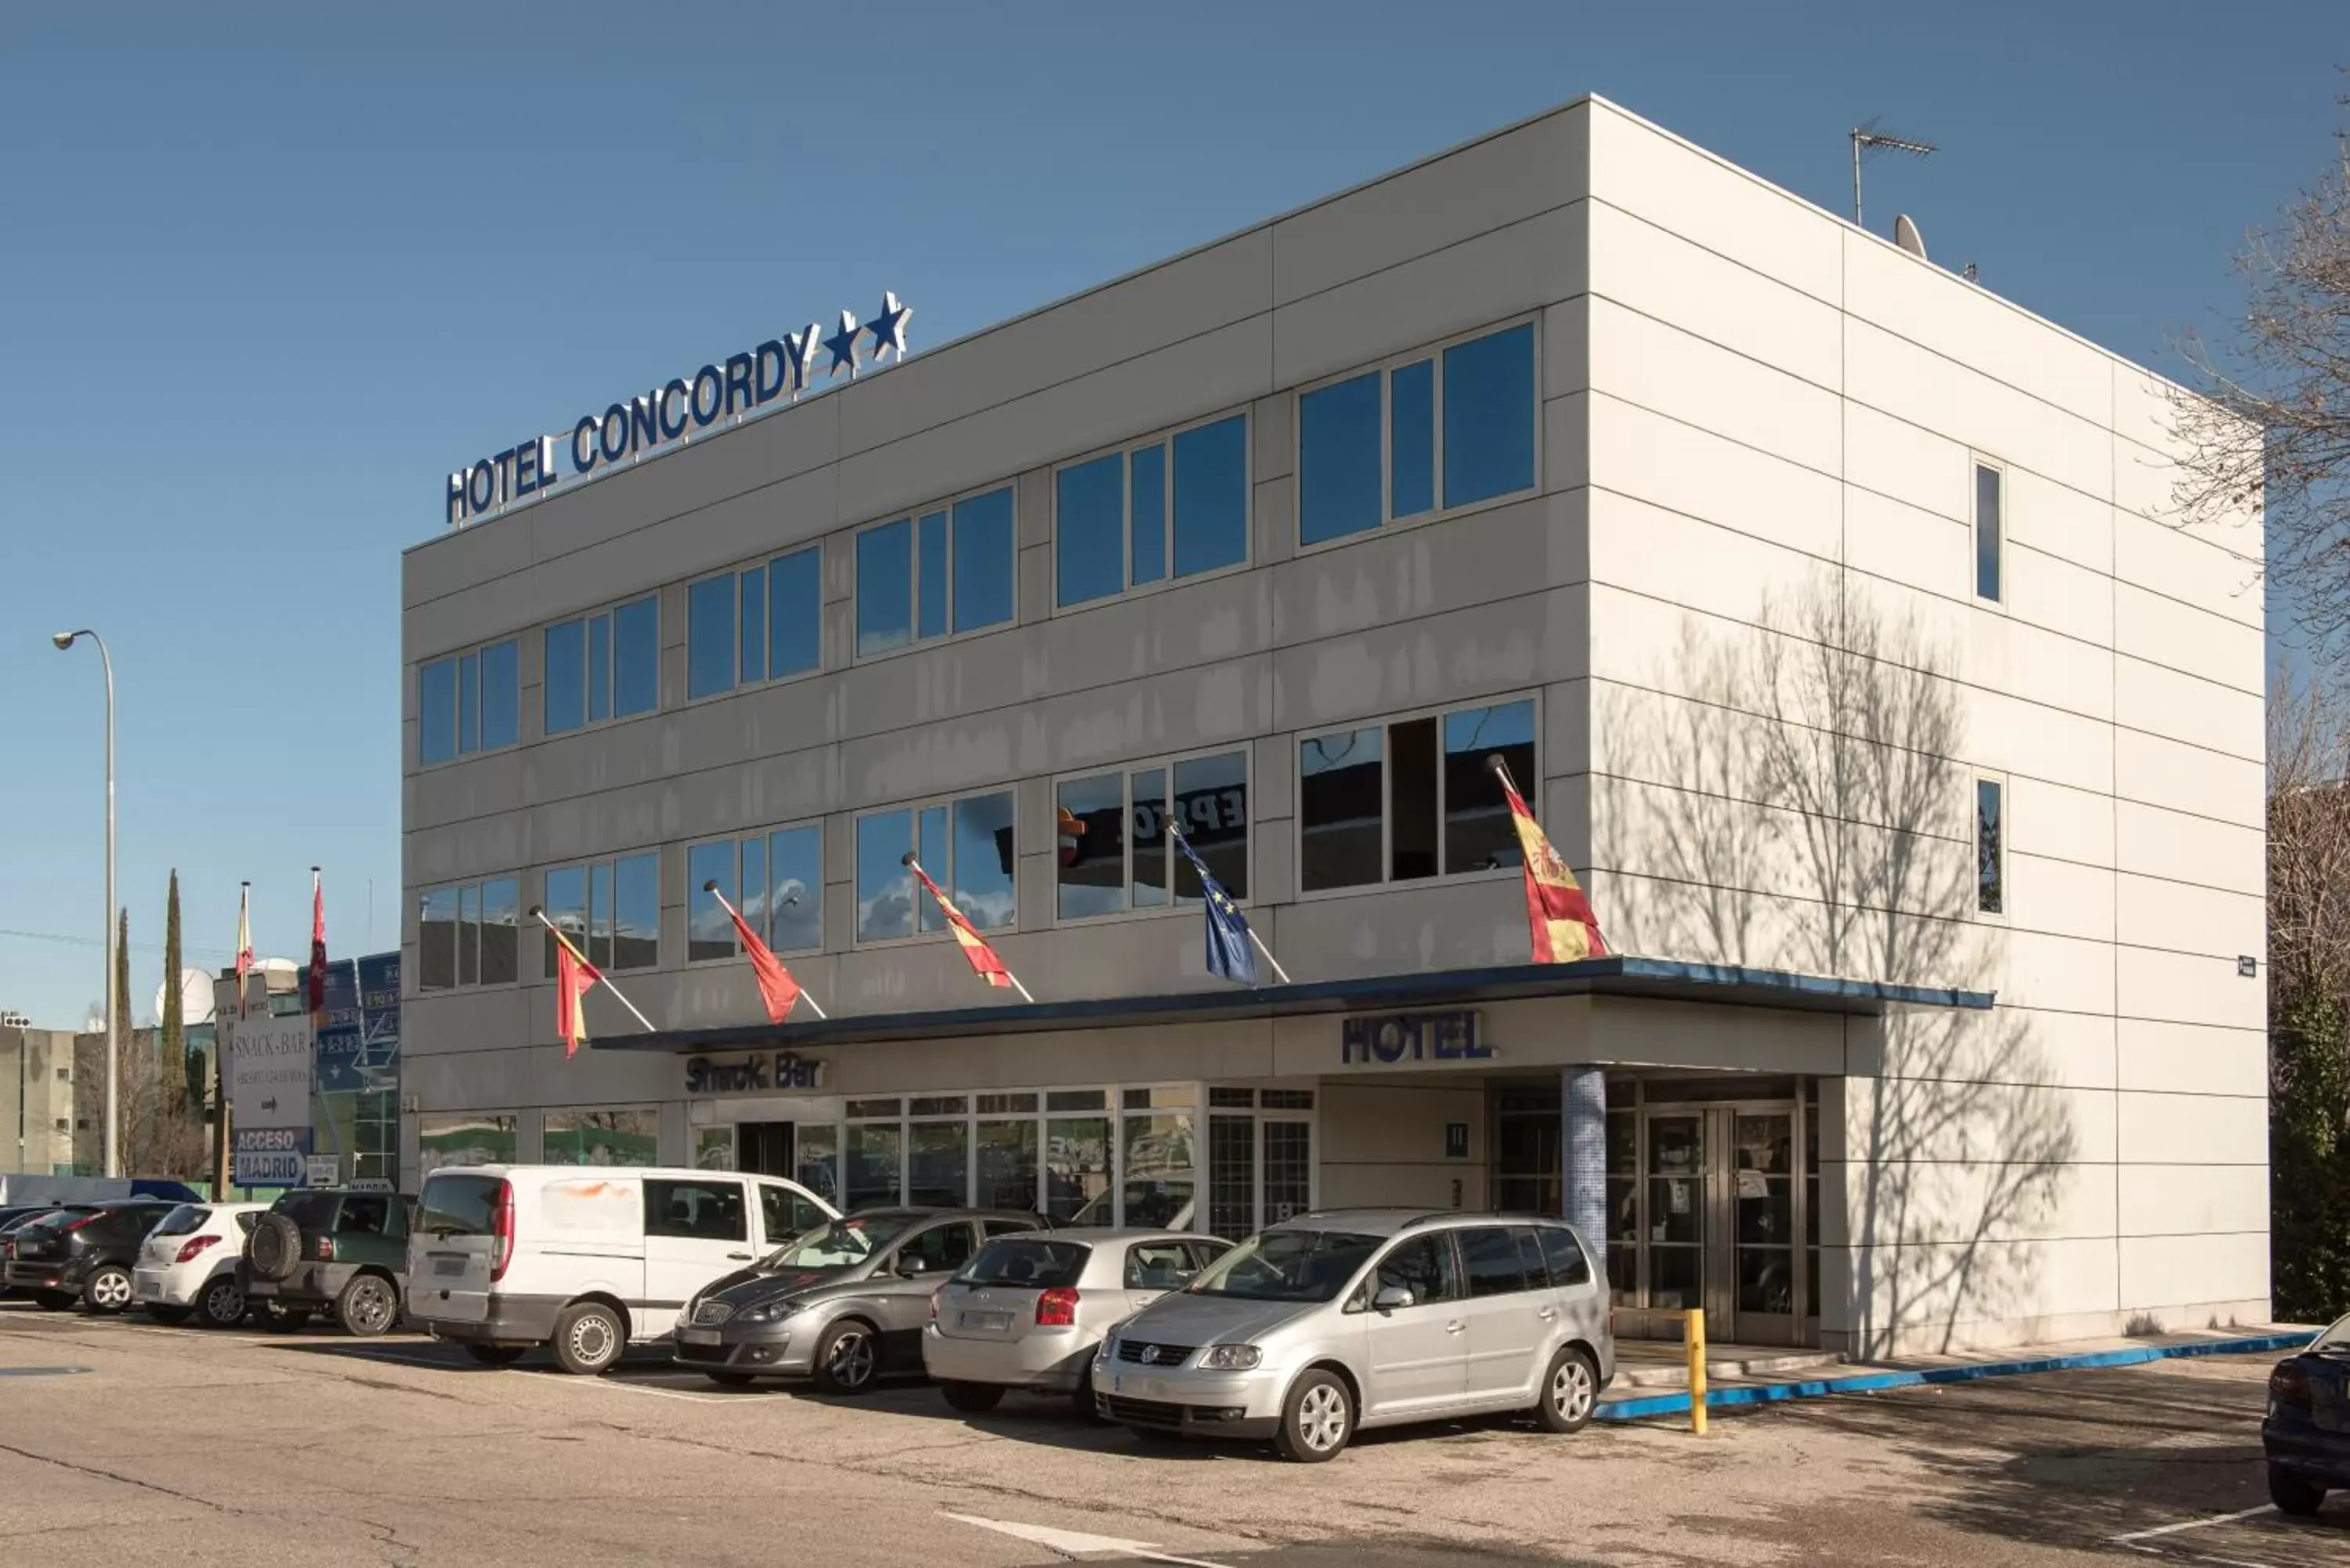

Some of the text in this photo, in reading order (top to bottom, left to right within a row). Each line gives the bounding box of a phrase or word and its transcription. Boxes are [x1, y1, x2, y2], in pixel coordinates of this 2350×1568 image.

[446, 323, 822, 524] HOTEL CONCORDY
[1342, 1010, 1498, 1064] HOTEL
[685, 1051, 827, 1092] Snack Bar
[237, 1130, 295, 1151] ACCESO
[239, 1156, 298, 1179] MADRID
